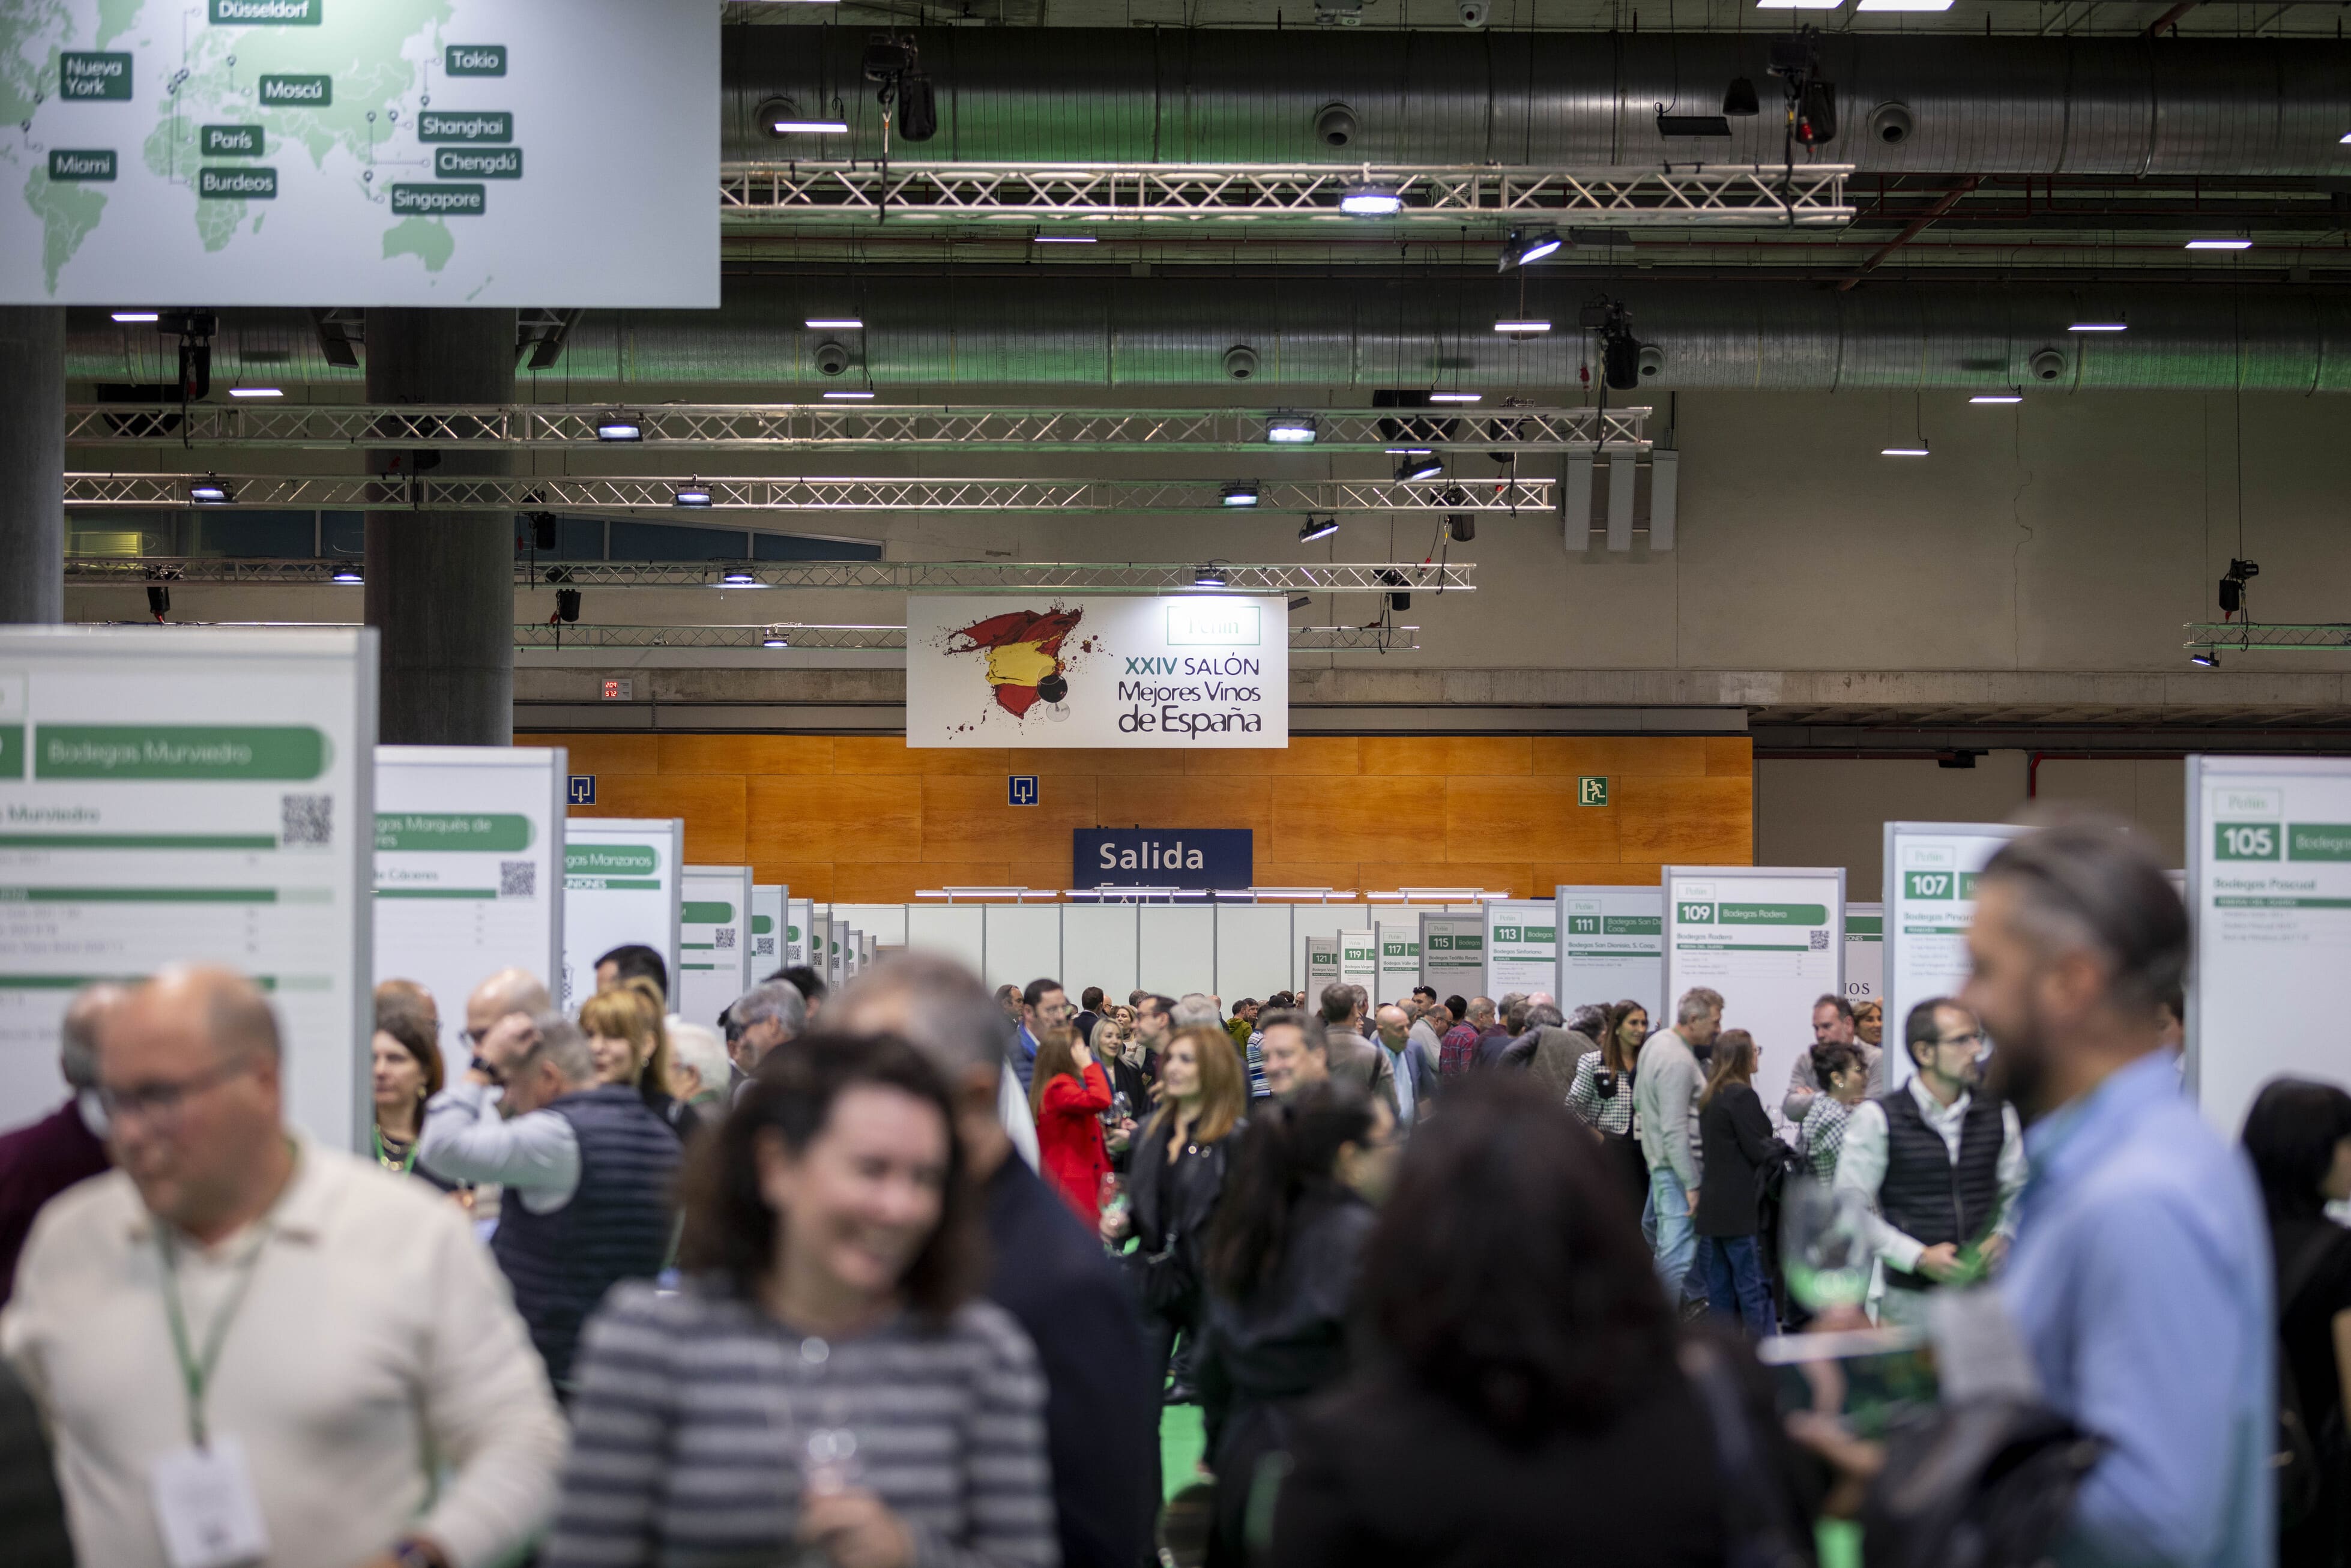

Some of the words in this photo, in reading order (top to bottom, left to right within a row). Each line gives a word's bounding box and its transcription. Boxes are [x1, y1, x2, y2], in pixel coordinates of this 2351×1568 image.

[219, 0, 309, 17] Düsseldorf
[66, 56, 122, 77] Nueva
[451, 50, 499, 68] Tokio
[66, 76, 106, 95] York
[265, 79, 322, 98] Moscú
[422, 116, 503, 138] Shanghai
[210, 130, 252, 149] París
[56, 154, 110, 174] Miami
[439, 152, 518, 174] Chengdú
[203, 172, 274, 191] Burdeos
[394, 189, 481, 211] Singapore
[1125, 657, 1177, 675] XXIV
[1185, 653, 1259, 675] SALÓN
[1118, 681, 1201, 707] Mejores
[1204, 681, 1261, 701] Vinos
[1118, 704, 1156, 732] de
[1162, 705, 1261, 740] España
[48, 738, 142, 768] Bodegas
[143, 738, 252, 765] Murviedro
[405, 816, 470, 834] Marqués
[471, 819, 492, 832] de
[2223, 827, 2274, 855] 105
[590, 853, 653, 867] Manzanos
[1100, 842, 1203, 869] Salida
[1911, 875, 1949, 895] 107
[2214, 878, 2266, 890] Bodegas
[2269, 878, 2316, 890] Pascual
[1682, 905, 1710, 920] 109
[1723, 909, 1757, 919] Bodegas
[1758, 909, 1787, 918] Rodero
[1499, 929, 1517, 939] 113
[1575, 918, 1593, 931] 111
[1607, 918, 1637, 926] Bodegas
[1388, 945, 1402, 954] 117
[1434, 938, 1449, 948] 115
